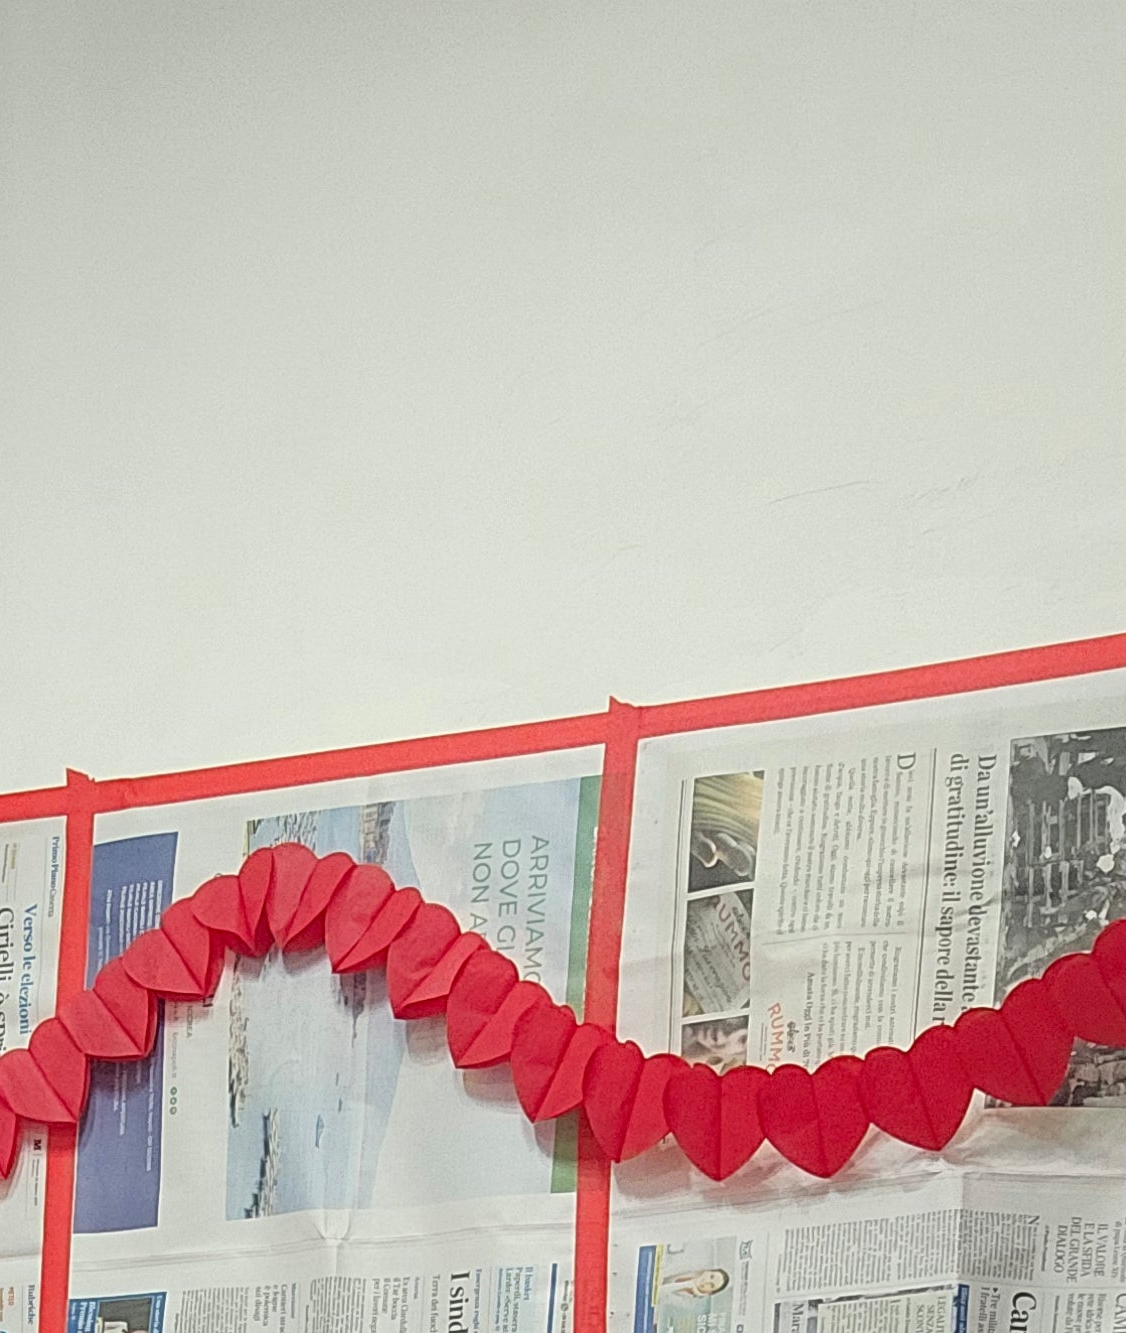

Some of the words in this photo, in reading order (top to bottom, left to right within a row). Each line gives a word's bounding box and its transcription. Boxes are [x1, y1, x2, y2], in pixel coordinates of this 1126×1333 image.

[949, 753, 969, 772] di
[977, 755, 997, 780] Da
[942, 776, 968, 887] gratitudine:
[471, 842, 492, 903] NON
[498, 839, 521, 917] DOVE
[941, 891, 961, 902] il
[23, 904, 38, 953] Verso
[934, 908, 956, 963] sapore
[961, 902, 984, 1002] devastante
[23, 956, 36, 969] le
[19, 973, 35, 1035] elezioni
[450, 1271, 470, 1280] I
